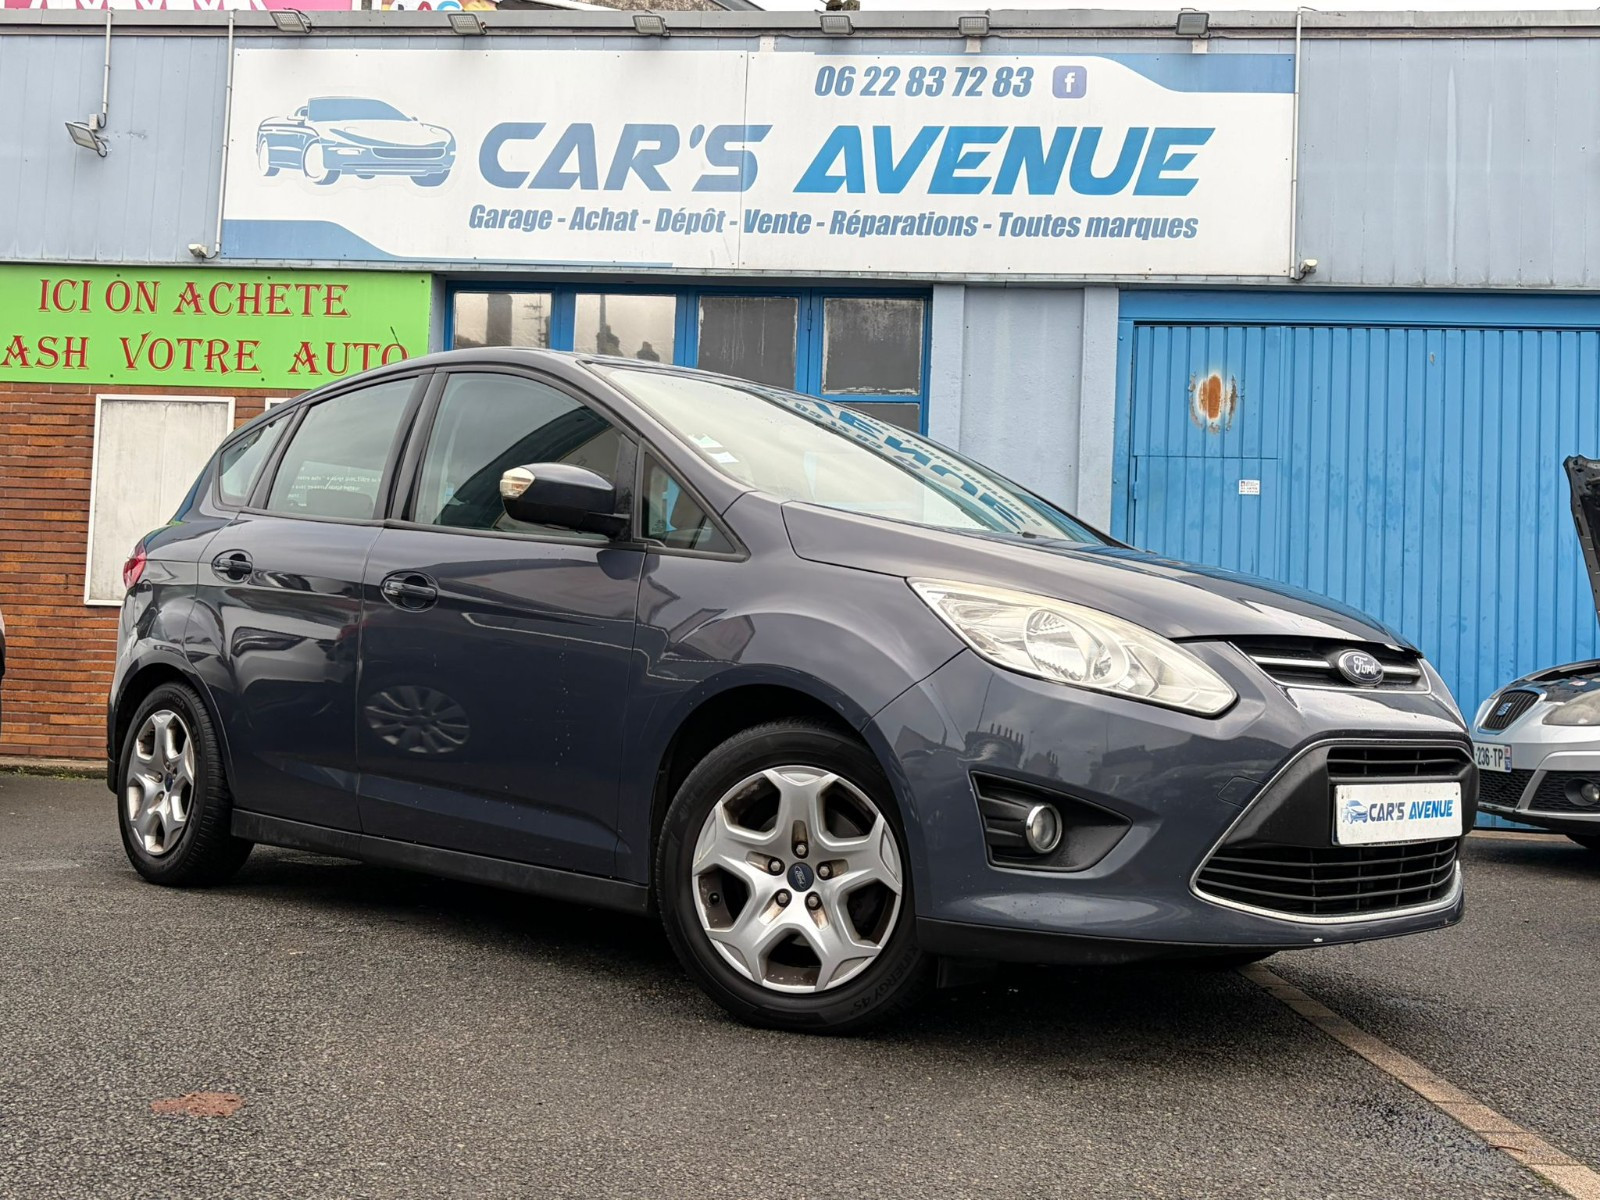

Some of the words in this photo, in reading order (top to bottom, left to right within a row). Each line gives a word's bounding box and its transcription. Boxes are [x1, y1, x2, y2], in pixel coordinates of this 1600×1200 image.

[815, 66, 857, 97] 06
[860, 66, 902, 97] 22
[905, 66, 948, 97] 83
[952, 66, 989, 97] 72
[992, 66, 1035, 98] 83
[479, 122, 773, 193] CAR'S
[793, 125, 1216, 197] AVENUE
[469, 204, 552, 233] Garage
[569, 206, 639, 232] Achat
[654, 207, 726, 235] Dépôt
[743, 208, 811, 236] Vente
[829, 210, 977, 238] Réparations
[999, 211, 1081, 238] Toutes
[1085, 216, 1199, 241] marques
[38, 279, 92, 313] ICI
[105, 280, 161, 315] ON
[173, 281, 351, 318] ACHETE
[119, 331, 261, 376] VOTRE
[288, 341, 410, 375] AUTO
[1353, 655, 1377, 675] Ford
[1369, 801, 1405, 823] CAR'S
[1408, 799, 1454, 820] AVENUE
